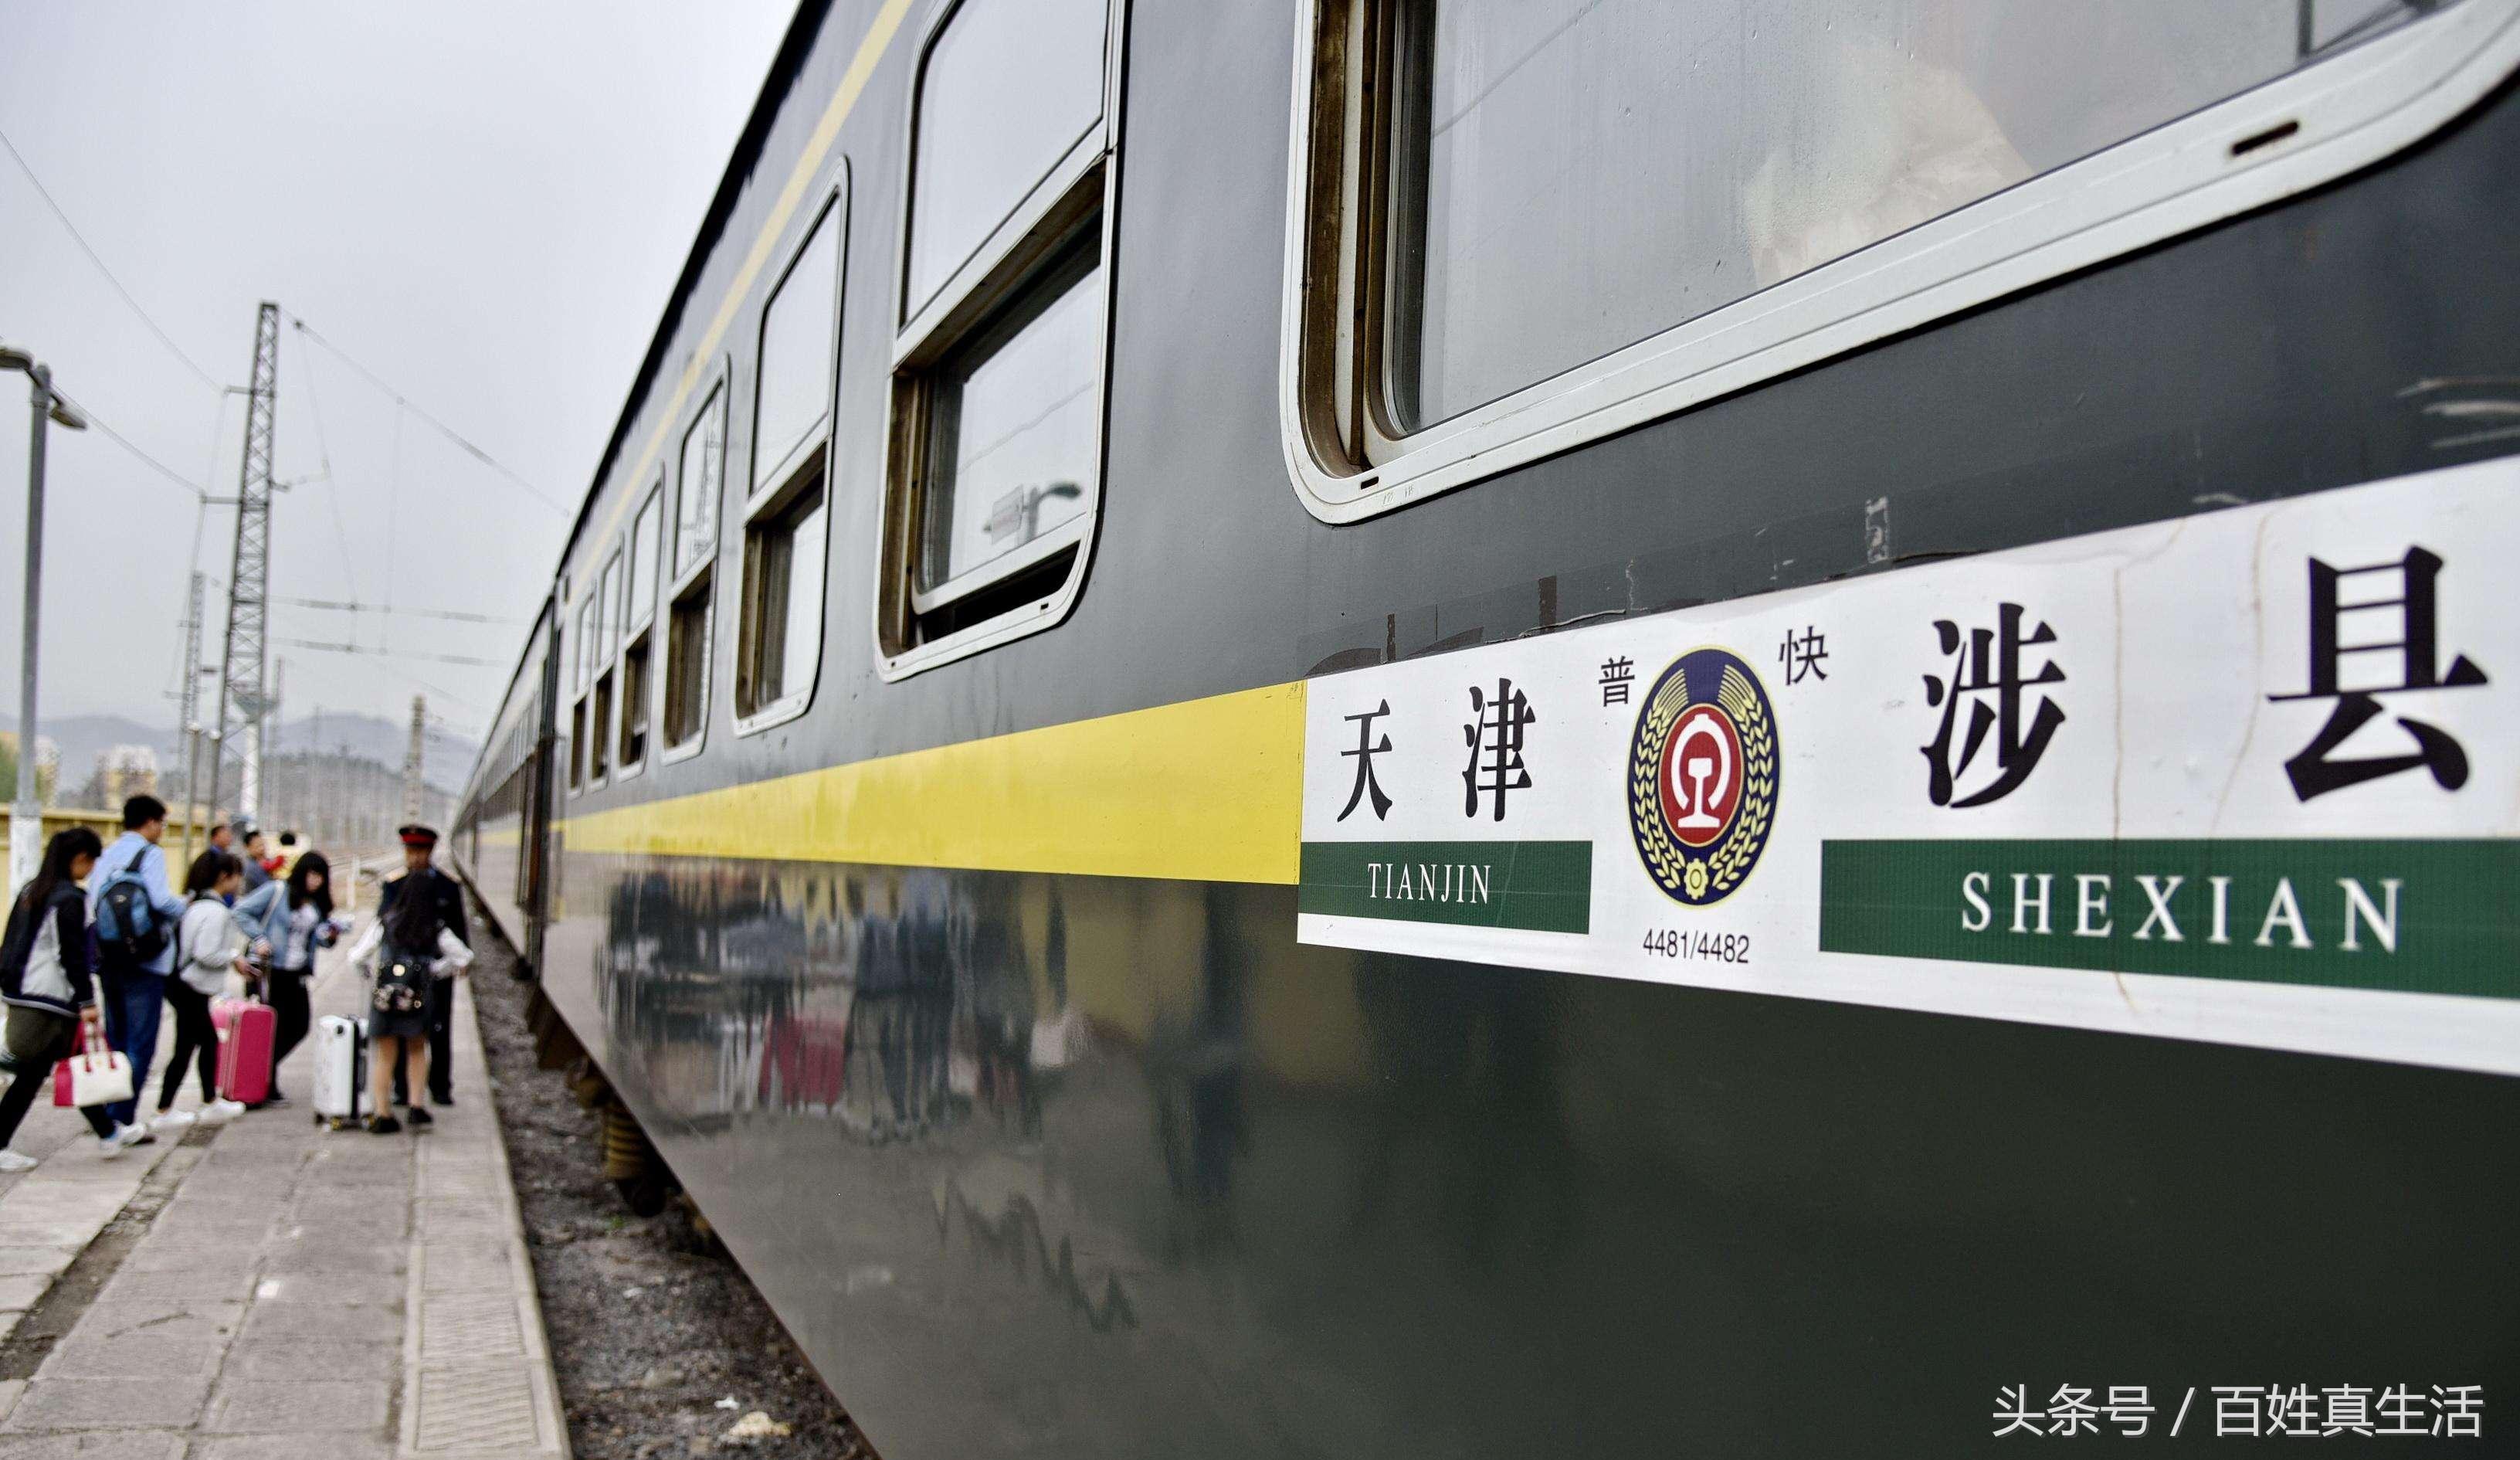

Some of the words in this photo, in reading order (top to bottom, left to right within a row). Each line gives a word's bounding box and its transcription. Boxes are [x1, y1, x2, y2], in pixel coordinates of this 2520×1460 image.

[1599, 656, 1636, 708] 普
[1779, 625, 1829, 686] 快
[1920, 545, 2489, 809] 涉县
[1337, 677, 1536, 823] 天津
[1367, 863, 1491, 905] TIANJIN
[1962, 871, 2403, 953] SHEXIAN
[1643, 929, 1751, 965] 4481/4482
